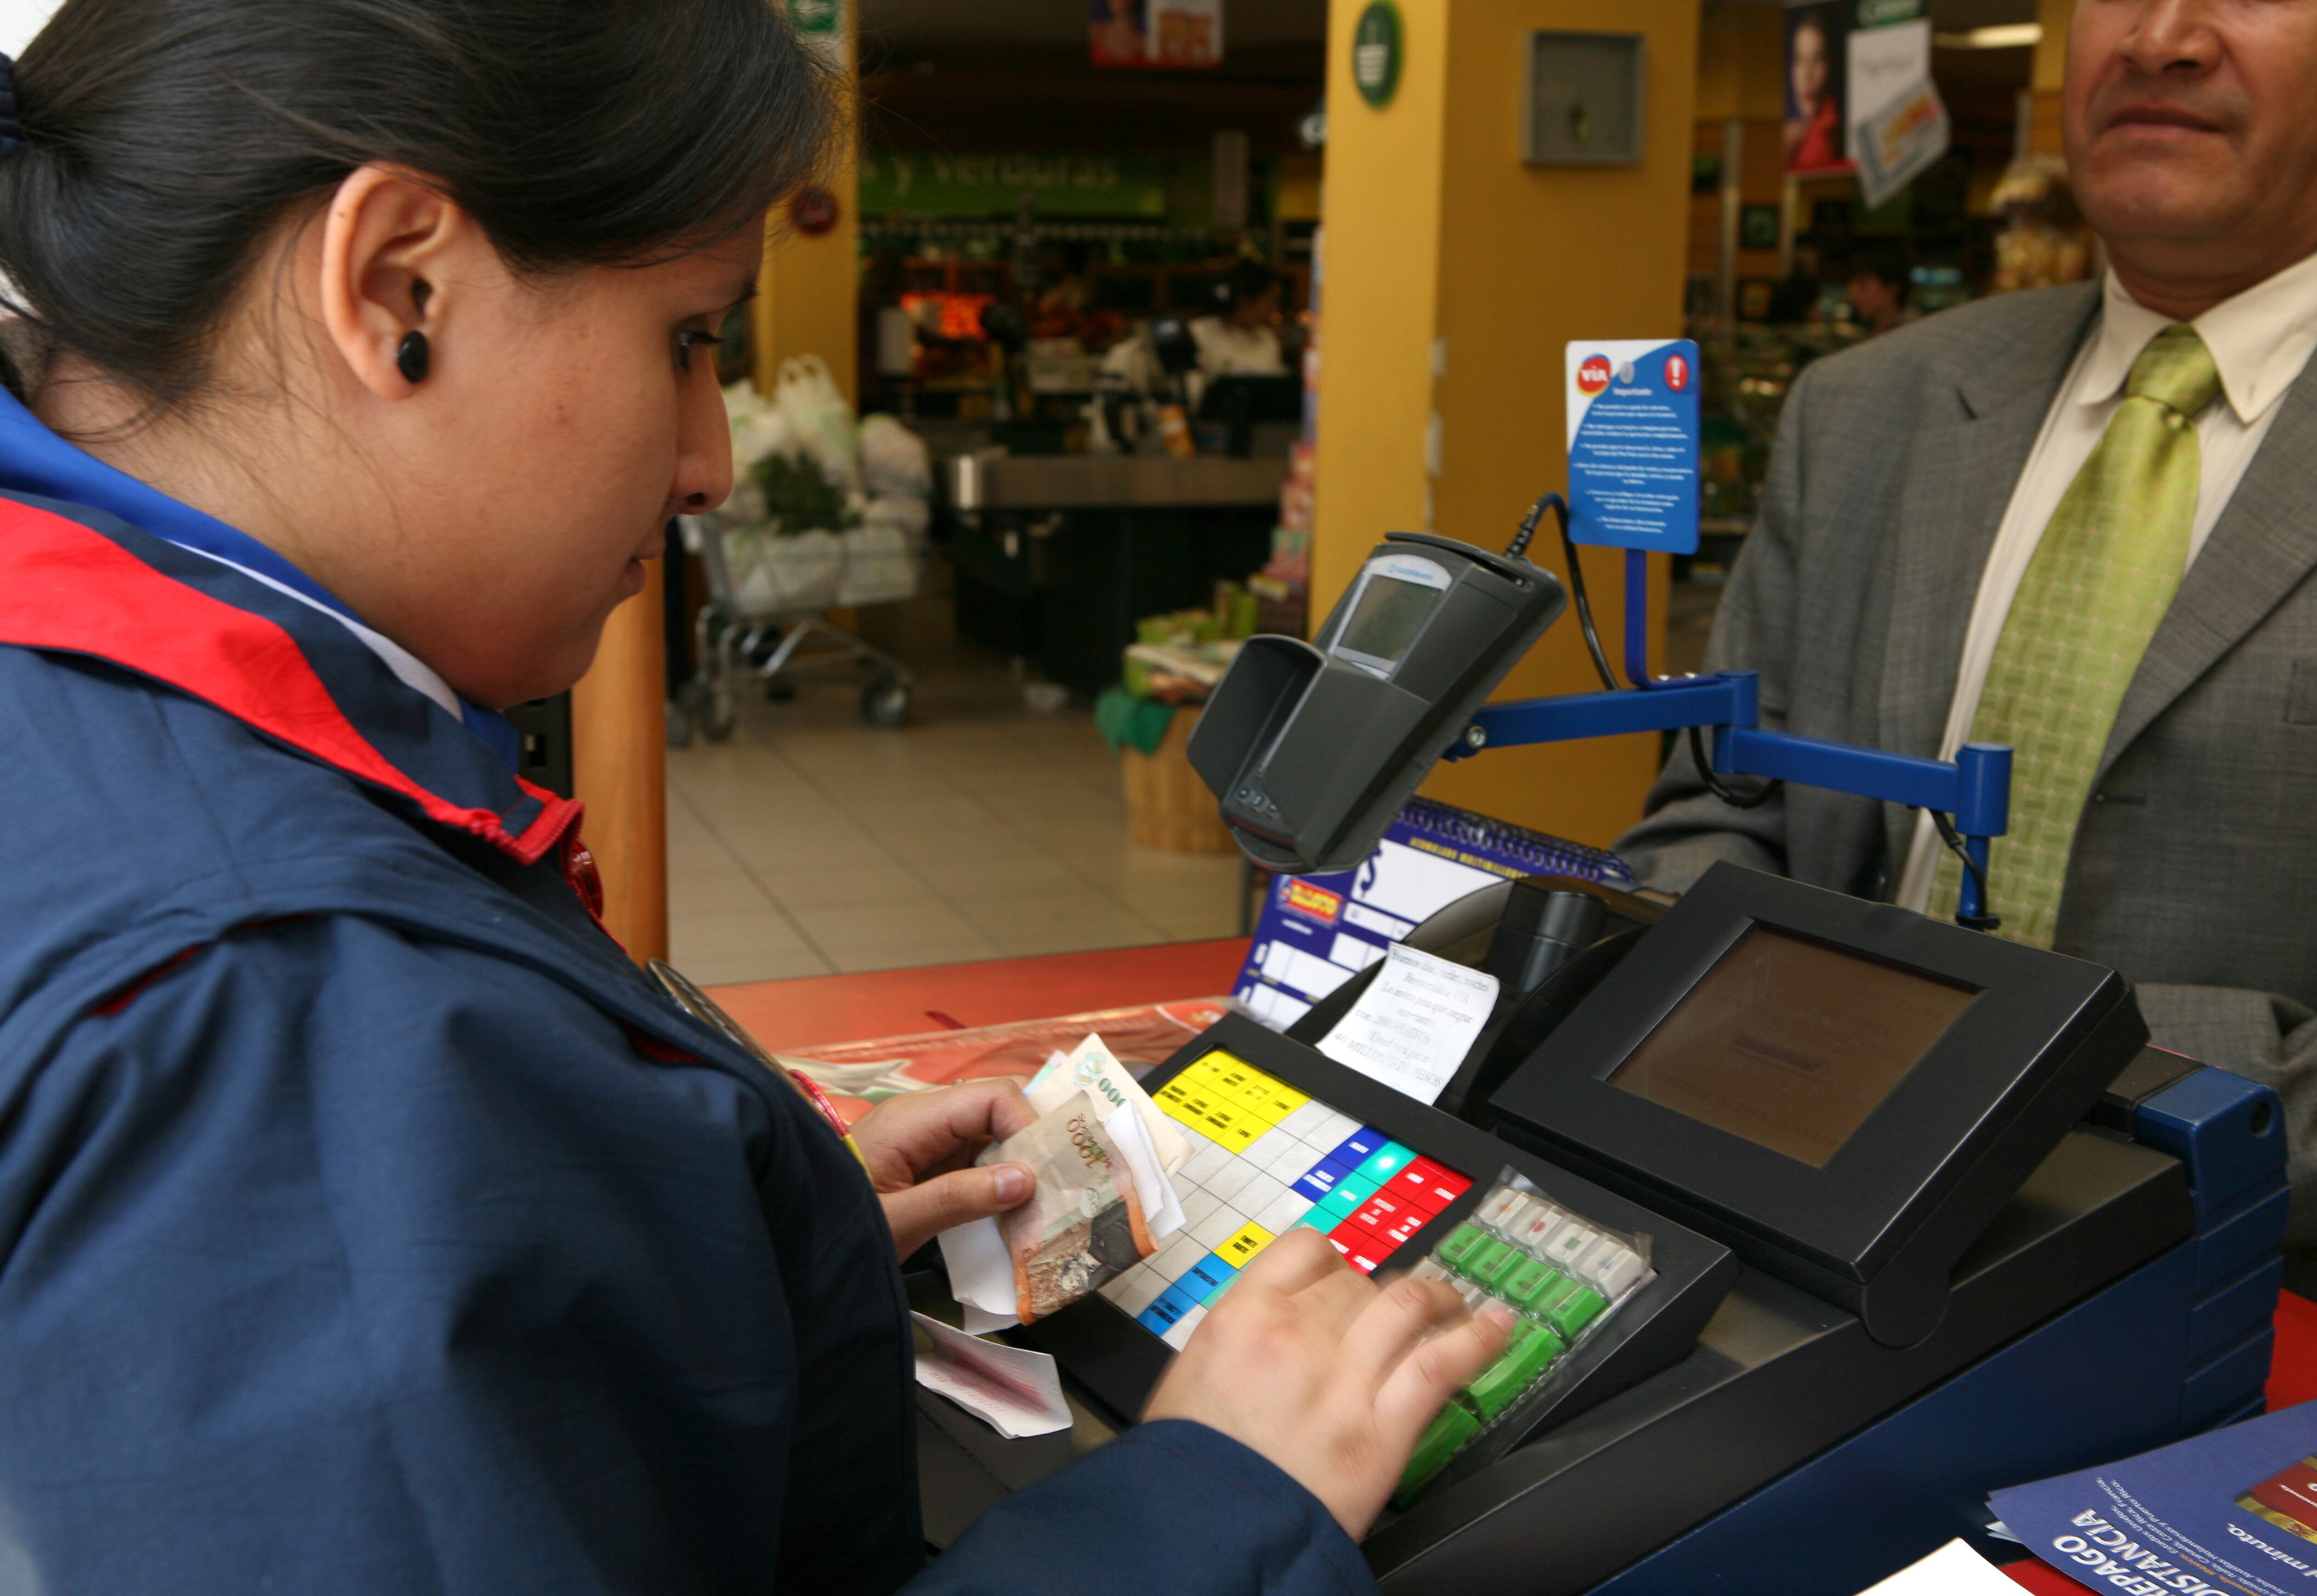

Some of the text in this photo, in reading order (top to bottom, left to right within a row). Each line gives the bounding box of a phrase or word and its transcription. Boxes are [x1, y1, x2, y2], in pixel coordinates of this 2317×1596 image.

[1333, 1031, 1349, 1045] 40
[1065, 1118, 1095, 1170] 1000
[1370, 1207, 1382, 1216] DE
[1405, 1216, 1422, 1227] PAGO
[1400, 1224, 1411, 1233] DE
[2096, 1477, 2127, 1508] Francia,
[2278, 1483, 2317, 1508] enezuela
[2111, 1504, 2143, 1532] Unidos,
[2126, 1507, 2148, 1525] Rica,
[2130, 1498, 2160, 1523] Puerto
[2142, 1530, 2178, 1554] Estados
[2147, 1523, 2172, 1542] Costa
[2165, 1526, 2218, 1560] Holandesas
[2227, 1523, 2310, 1570] minuto.
[2218, 1558, 2256, 1578] Antillas
